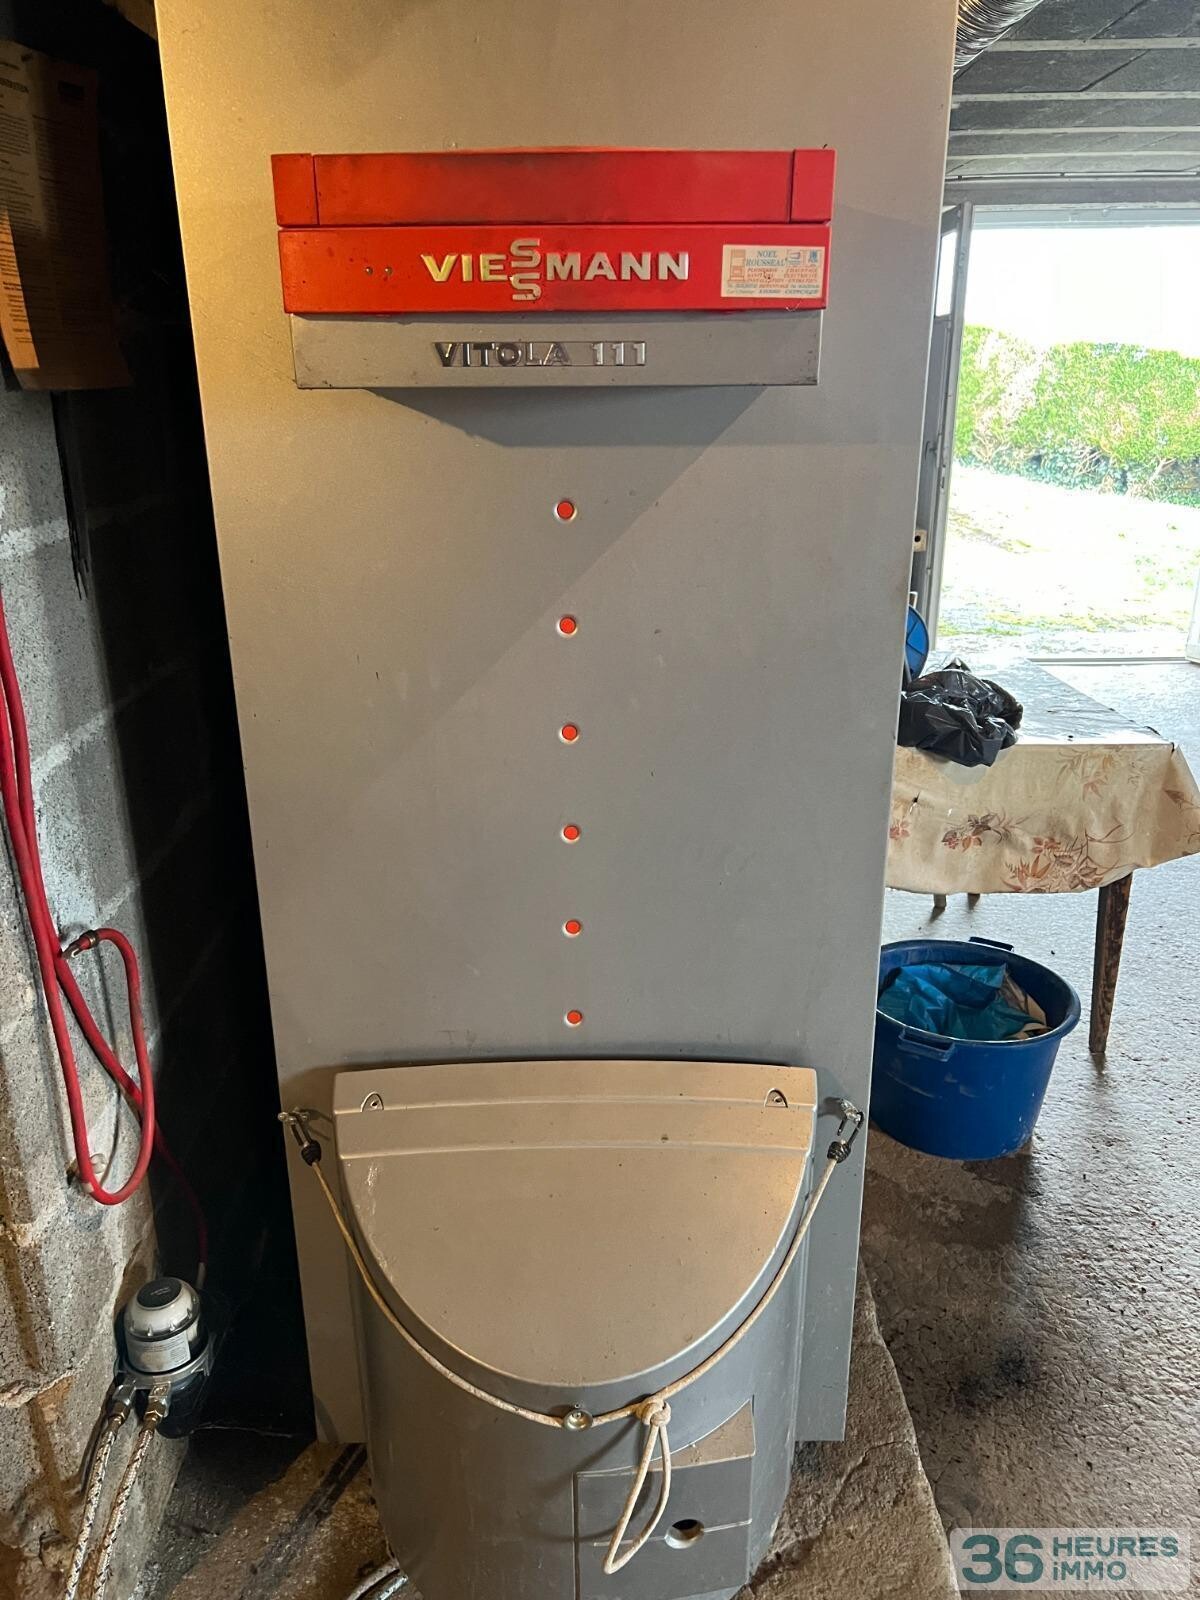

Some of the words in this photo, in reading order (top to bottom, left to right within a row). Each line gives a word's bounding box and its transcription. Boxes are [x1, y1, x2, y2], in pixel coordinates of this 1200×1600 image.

[420, 238, 690, 301] VIESSMANN
[434, 341, 571, 367] VITOLA
[591, 341, 646, 367] 111
